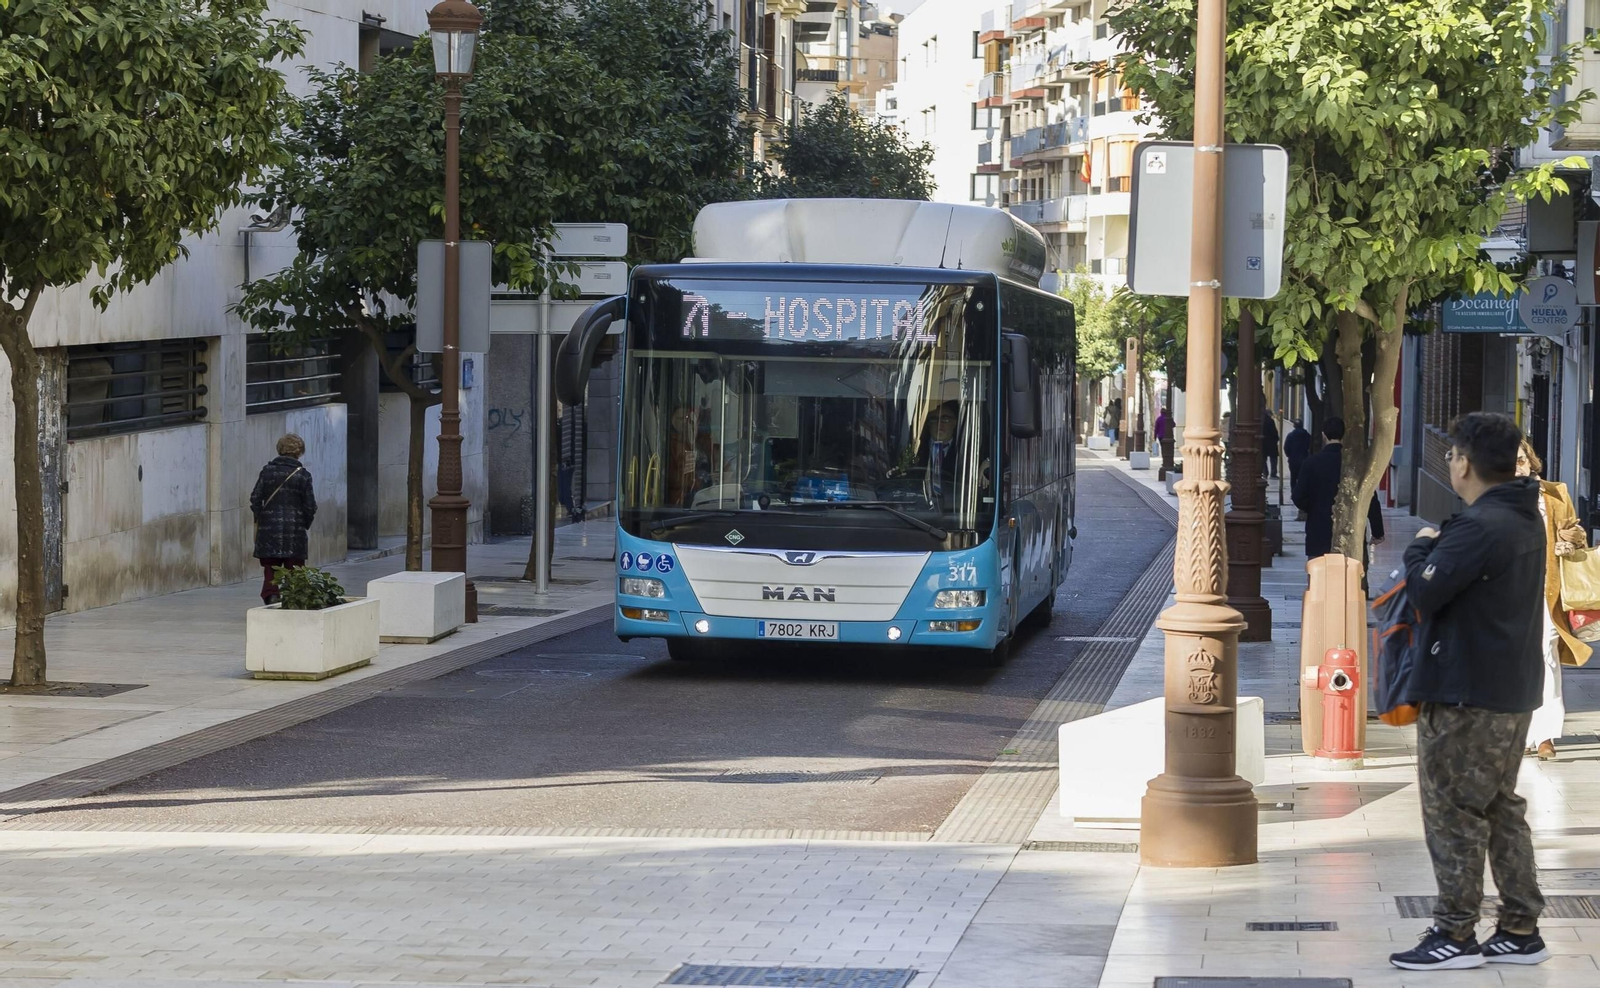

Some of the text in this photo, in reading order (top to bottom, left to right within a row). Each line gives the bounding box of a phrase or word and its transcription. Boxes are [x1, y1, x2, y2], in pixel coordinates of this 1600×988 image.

[763, 296, 937, 341] HOSPITAL
[1531, 308, 1568, 316] HUELVA
[1531, 316, 1568, 324] CENTRO
[948, 566, 977, 582] 317
[762, 585, 836, 602] MAN
[769, 623, 836, 638] 7802 KRJ
